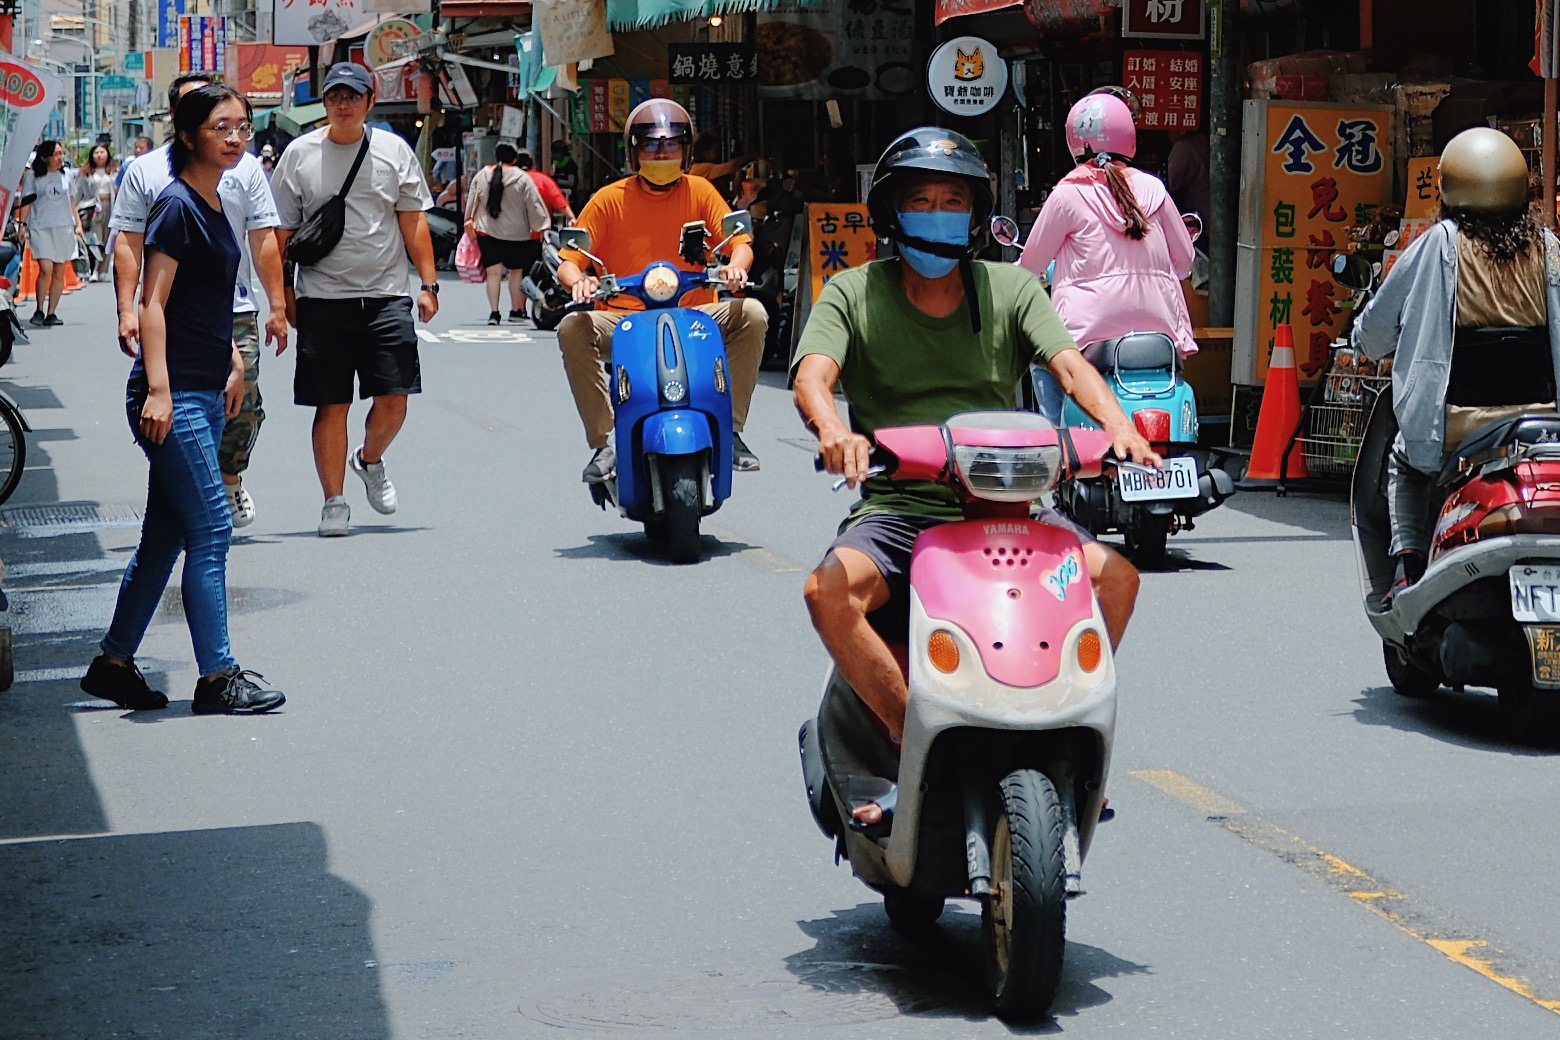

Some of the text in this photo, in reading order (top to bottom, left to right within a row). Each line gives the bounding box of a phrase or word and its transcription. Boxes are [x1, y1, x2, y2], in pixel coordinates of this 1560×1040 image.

[1273, 115, 1384, 175] 全冠
[817, 211, 873, 235] 古早
[1269, 200, 1297, 364] 包裝材
[1299, 176, 1348, 378] 免洗餐具
[983, 524, 1030, 536] YAMAHA
